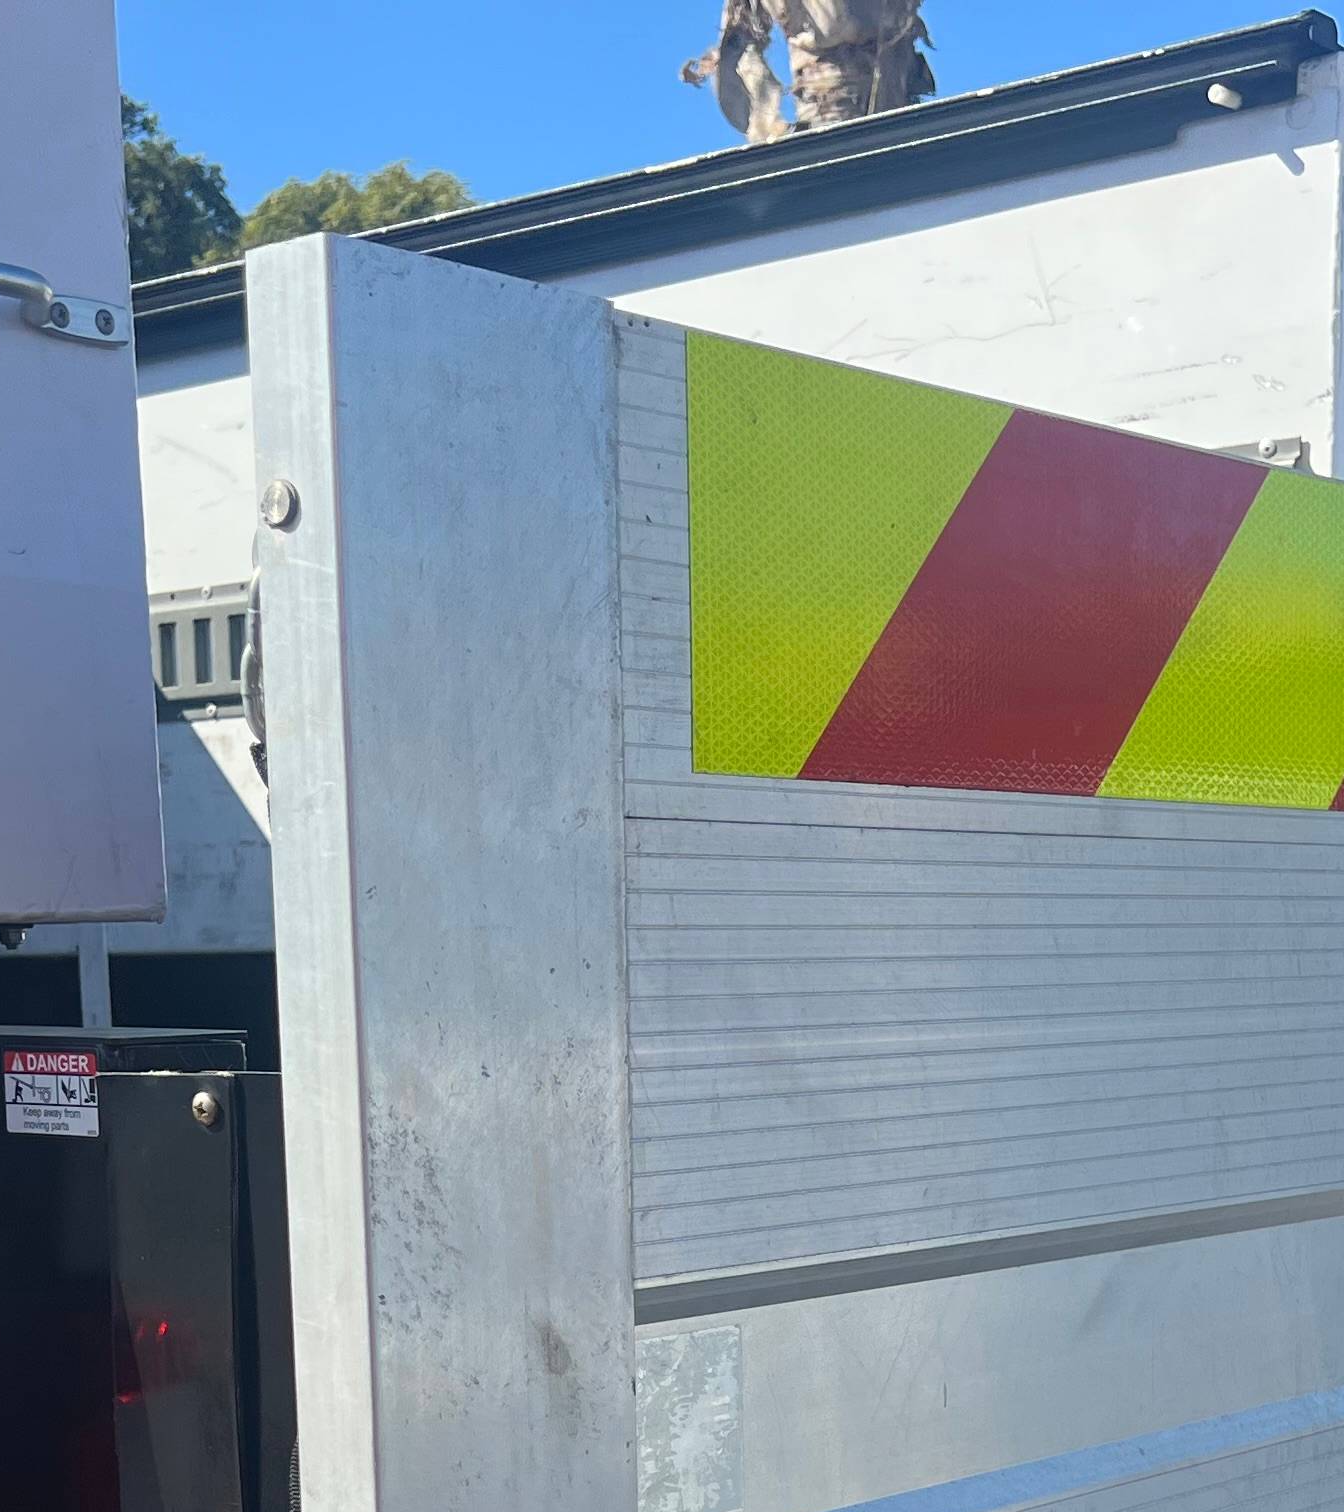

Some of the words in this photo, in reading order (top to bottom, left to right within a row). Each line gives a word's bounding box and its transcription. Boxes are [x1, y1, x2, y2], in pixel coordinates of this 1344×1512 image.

[27, 1053, 89, 1073] DANGER
[23, 1106, 42, 1118] Keep
[44, 1109, 62, 1120] away
[64, 1108, 81, 1118] from
[24, 1121, 49, 1132] moving
[51, 1122, 69, 1131] parts
